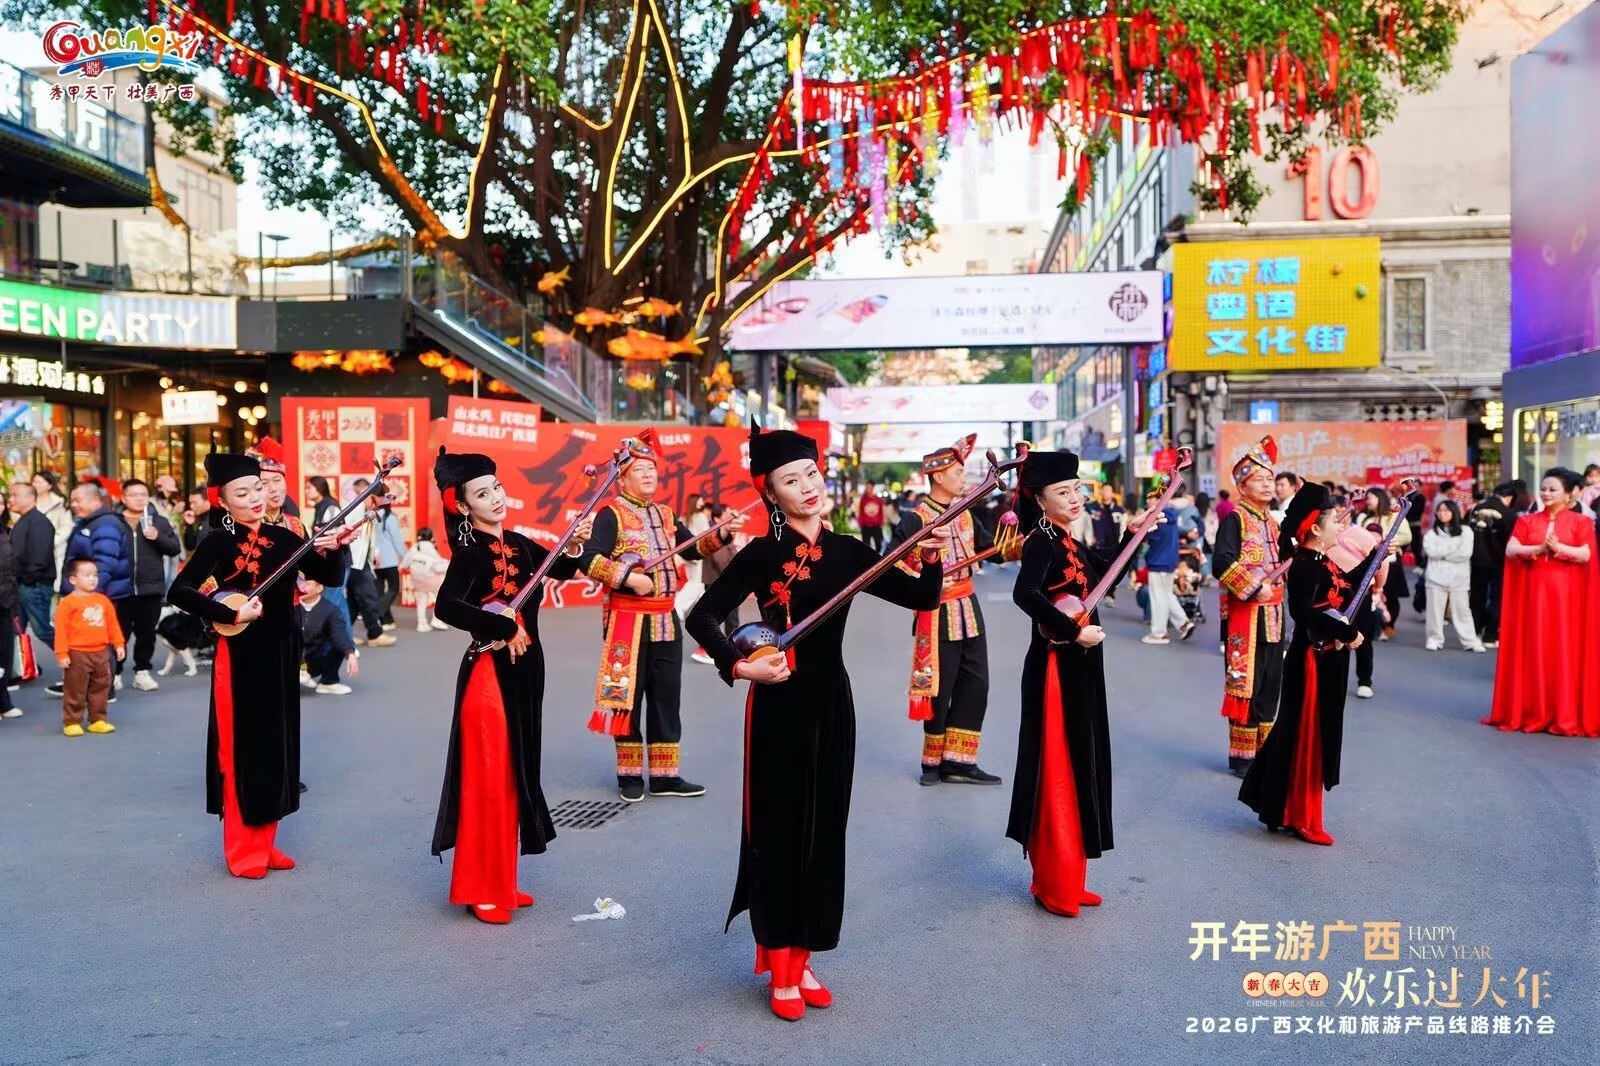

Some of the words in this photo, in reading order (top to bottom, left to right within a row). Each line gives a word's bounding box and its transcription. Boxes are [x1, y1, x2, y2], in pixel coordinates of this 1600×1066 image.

[1207, 256, 1300, 286] 柠檬
[77, 307, 199, 343] PARTY
[1206, 324, 1348, 357] 文化街
